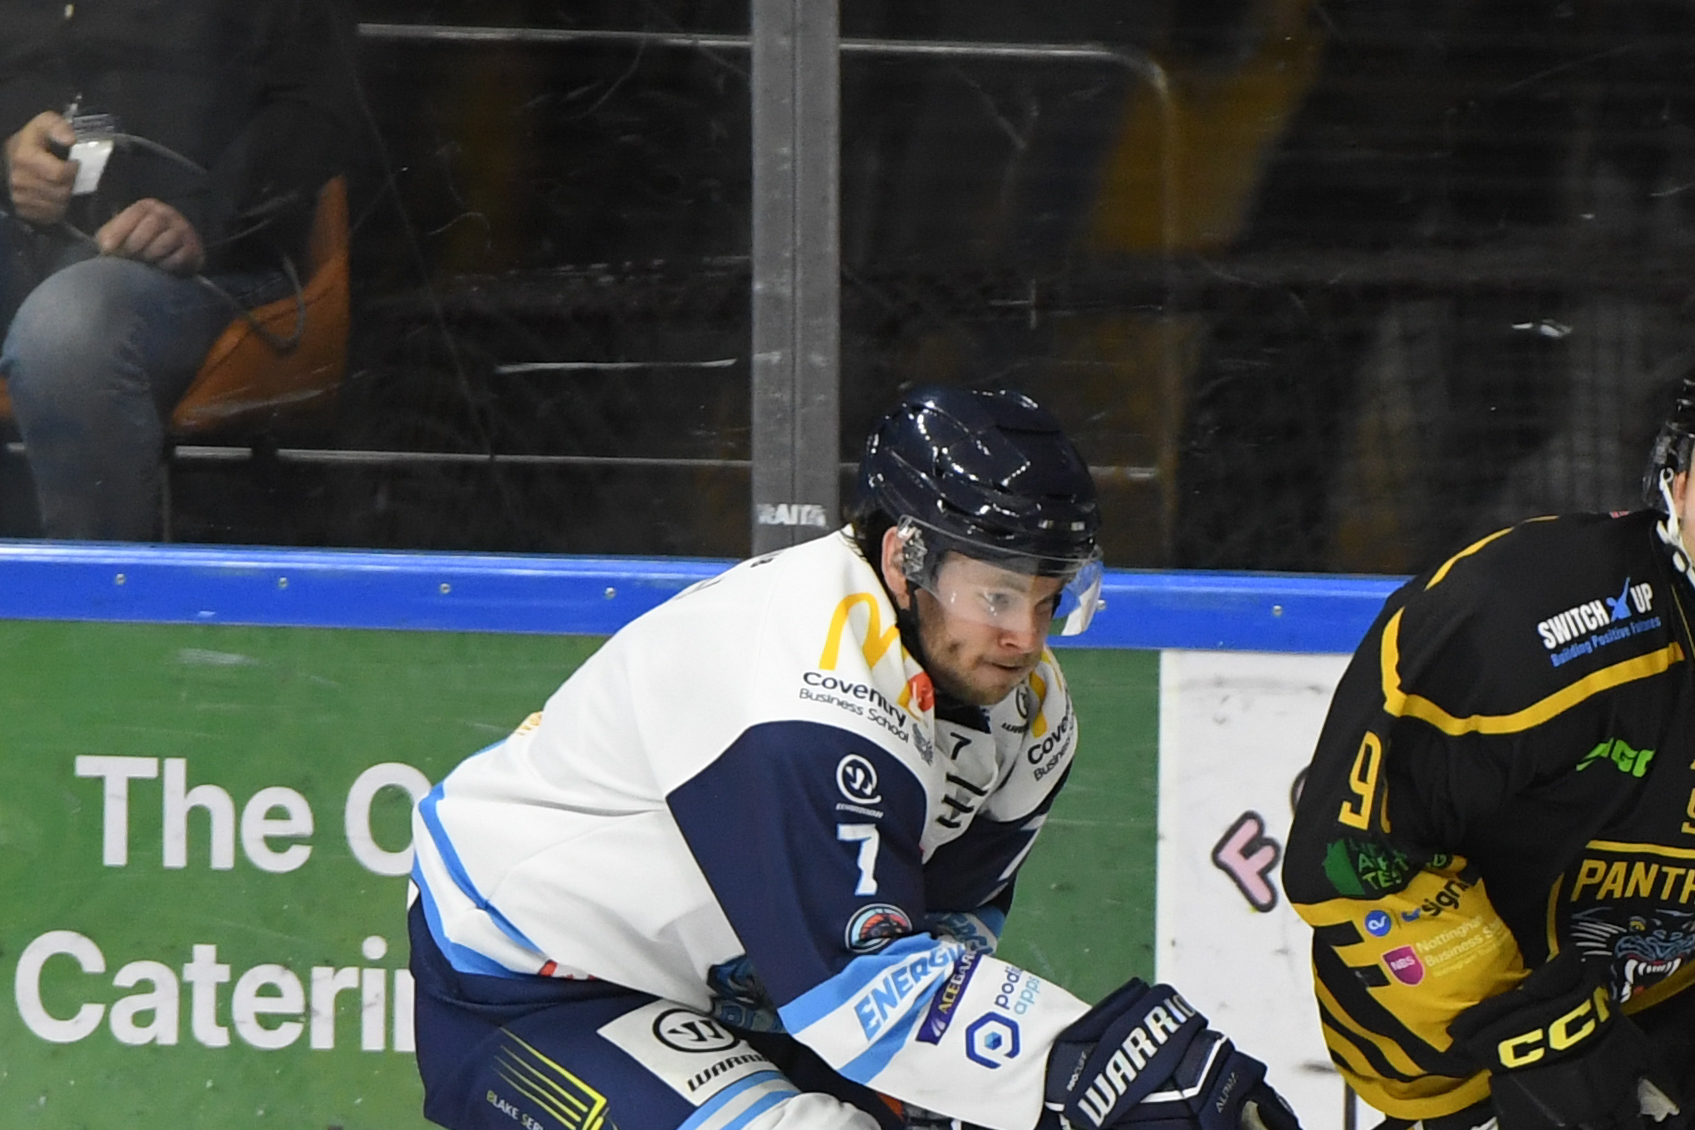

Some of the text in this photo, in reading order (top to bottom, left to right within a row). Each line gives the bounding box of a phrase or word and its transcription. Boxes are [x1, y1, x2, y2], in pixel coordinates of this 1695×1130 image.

[1538, 582, 1653, 649] SWITCH UP
[1550, 641, 1593, 667] Building
[799, 688, 909, 743] Business School
[803, 672, 906, 726] Coventry
[951, 732, 971, 760] 7
[75, 755, 314, 872] The
[837, 824, 880, 896] 7
[1078, 995, 1195, 1127] WARRIO
[486, 1090, 519, 1119] BLAKE
